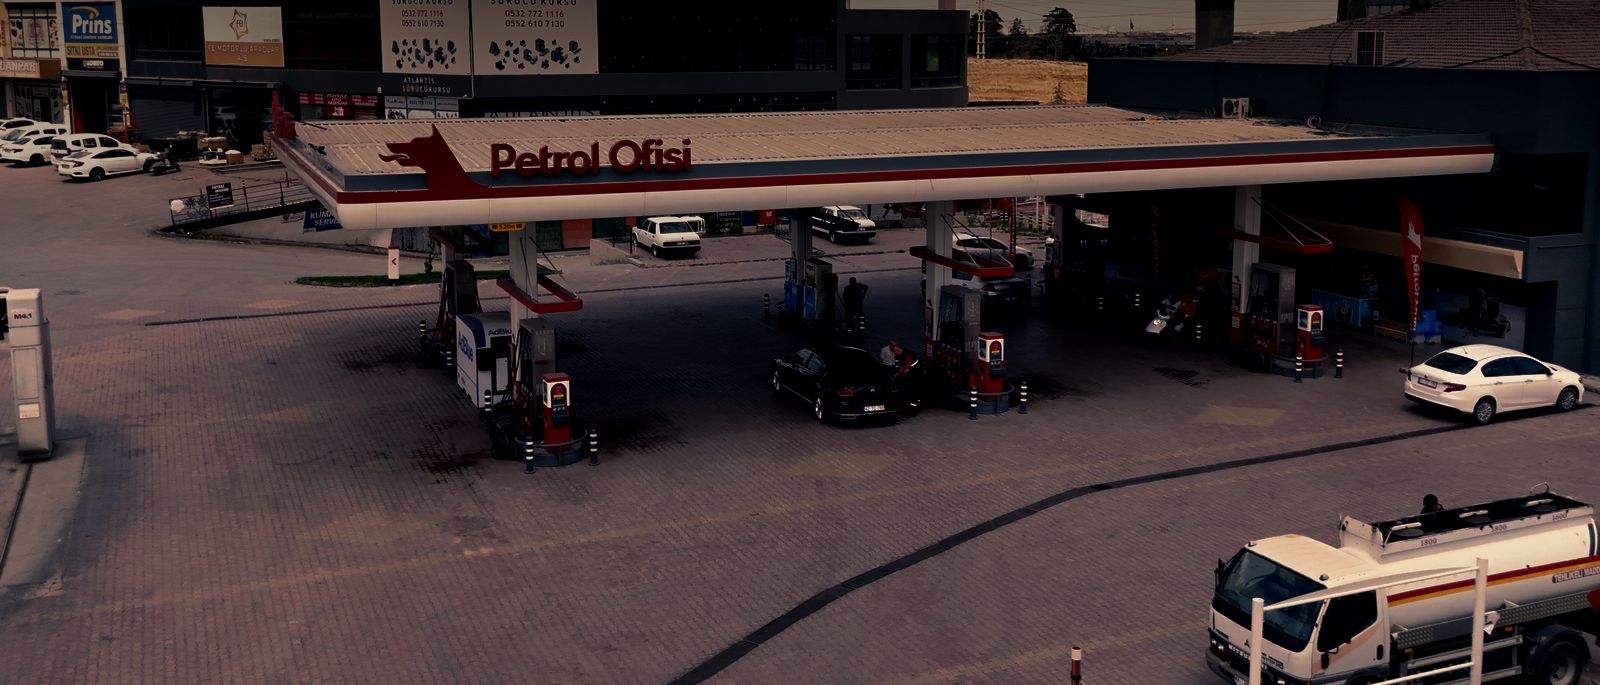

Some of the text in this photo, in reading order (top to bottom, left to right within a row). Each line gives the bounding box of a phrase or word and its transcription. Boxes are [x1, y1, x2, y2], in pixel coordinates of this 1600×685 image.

[504, 10, 565, 18] 0532 772 1116
[72, 13, 113, 34] Prins
[491, 138, 692, 179] Petrol Ofisi
[488, 328, 512, 336] AdBlu
[1420, 537, 1438, 547] 1800
